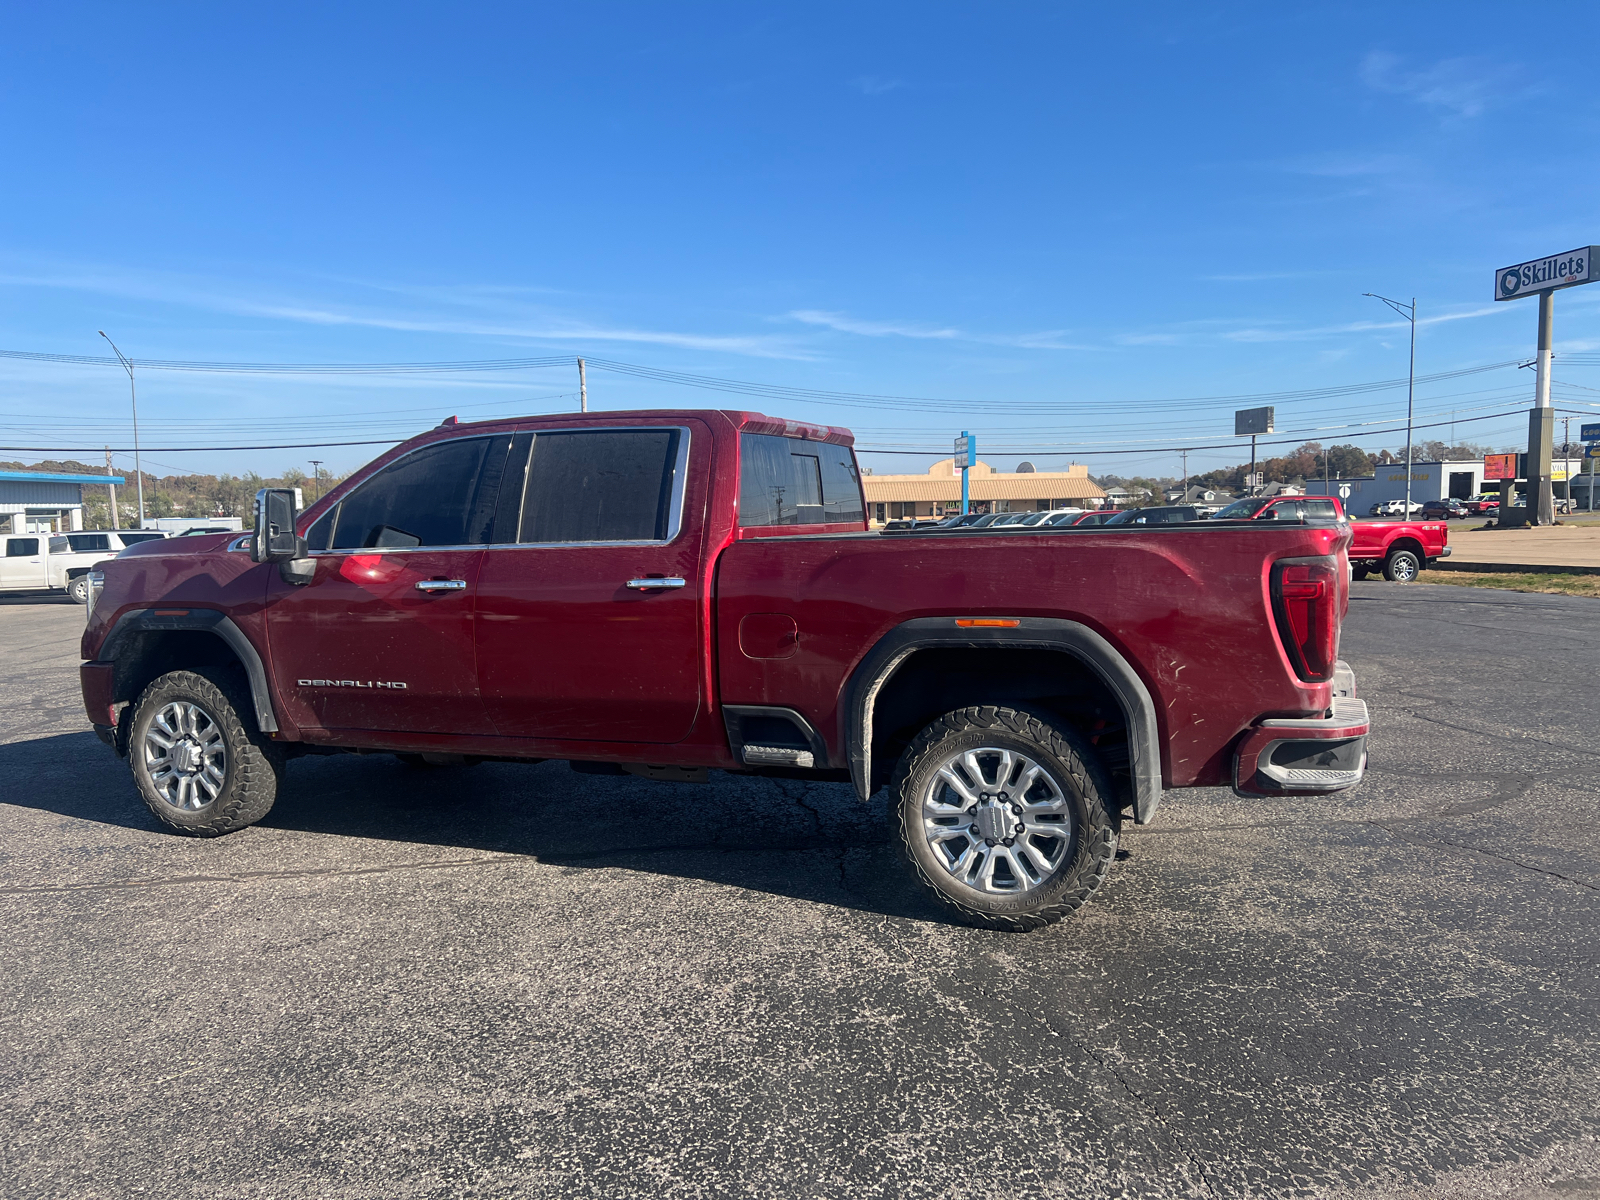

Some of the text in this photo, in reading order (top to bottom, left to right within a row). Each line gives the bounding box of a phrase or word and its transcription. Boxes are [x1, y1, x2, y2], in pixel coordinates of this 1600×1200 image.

[1522, 256, 1584, 287] Skillets
[297, 679, 407, 689] DENALI HD
